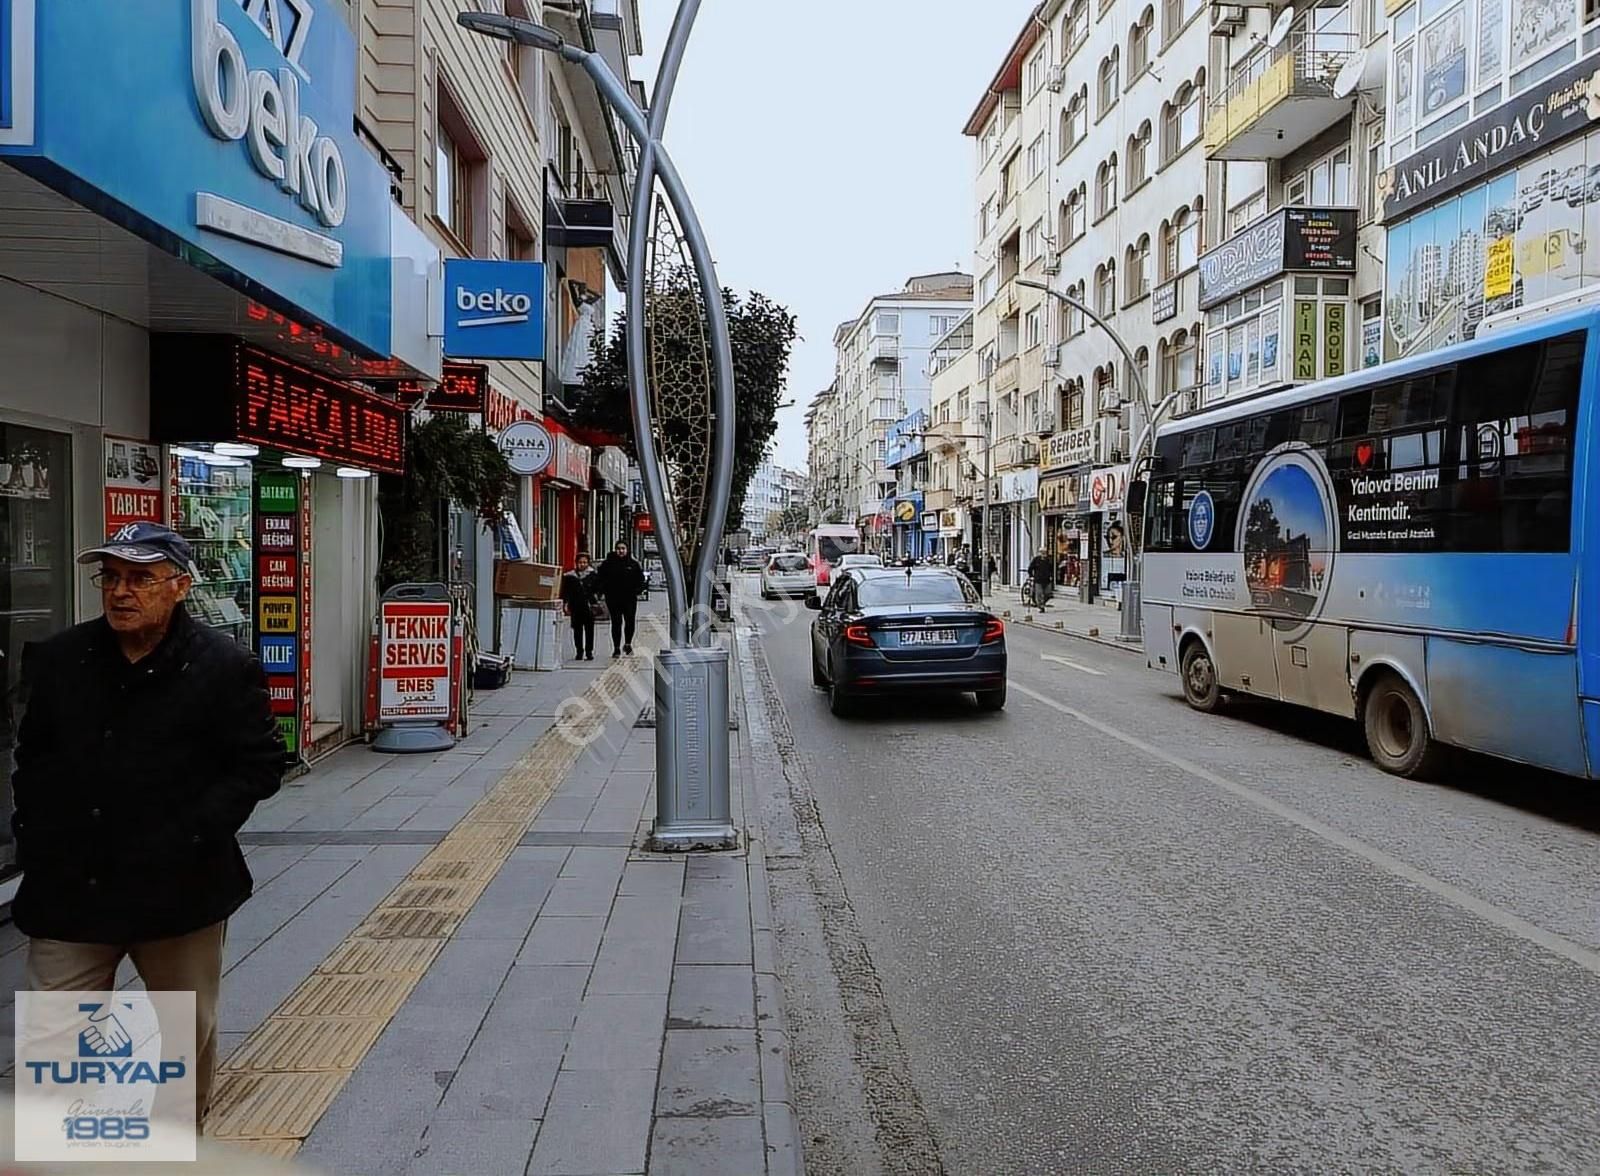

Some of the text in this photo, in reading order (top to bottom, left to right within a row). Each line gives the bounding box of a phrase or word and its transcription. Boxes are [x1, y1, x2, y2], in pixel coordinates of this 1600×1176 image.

[191, 0, 348, 228] beko
[1395, 103, 1545, 201] ANIL ANDAÇ
[456, 286, 530, 313] beko
[1328, 307, 1341, 373] GROUP
[506, 438, 545, 447] NANA
[1050, 429, 1091, 456] REHBER
[1351, 468, 1439, 496] Yalova Benim
[109, 492, 157, 517] TABLET
[1348, 501, 1411, 522] Kentimdir.
[263, 645, 293, 664] KILIF
[396, 679, 435, 693] ENES
